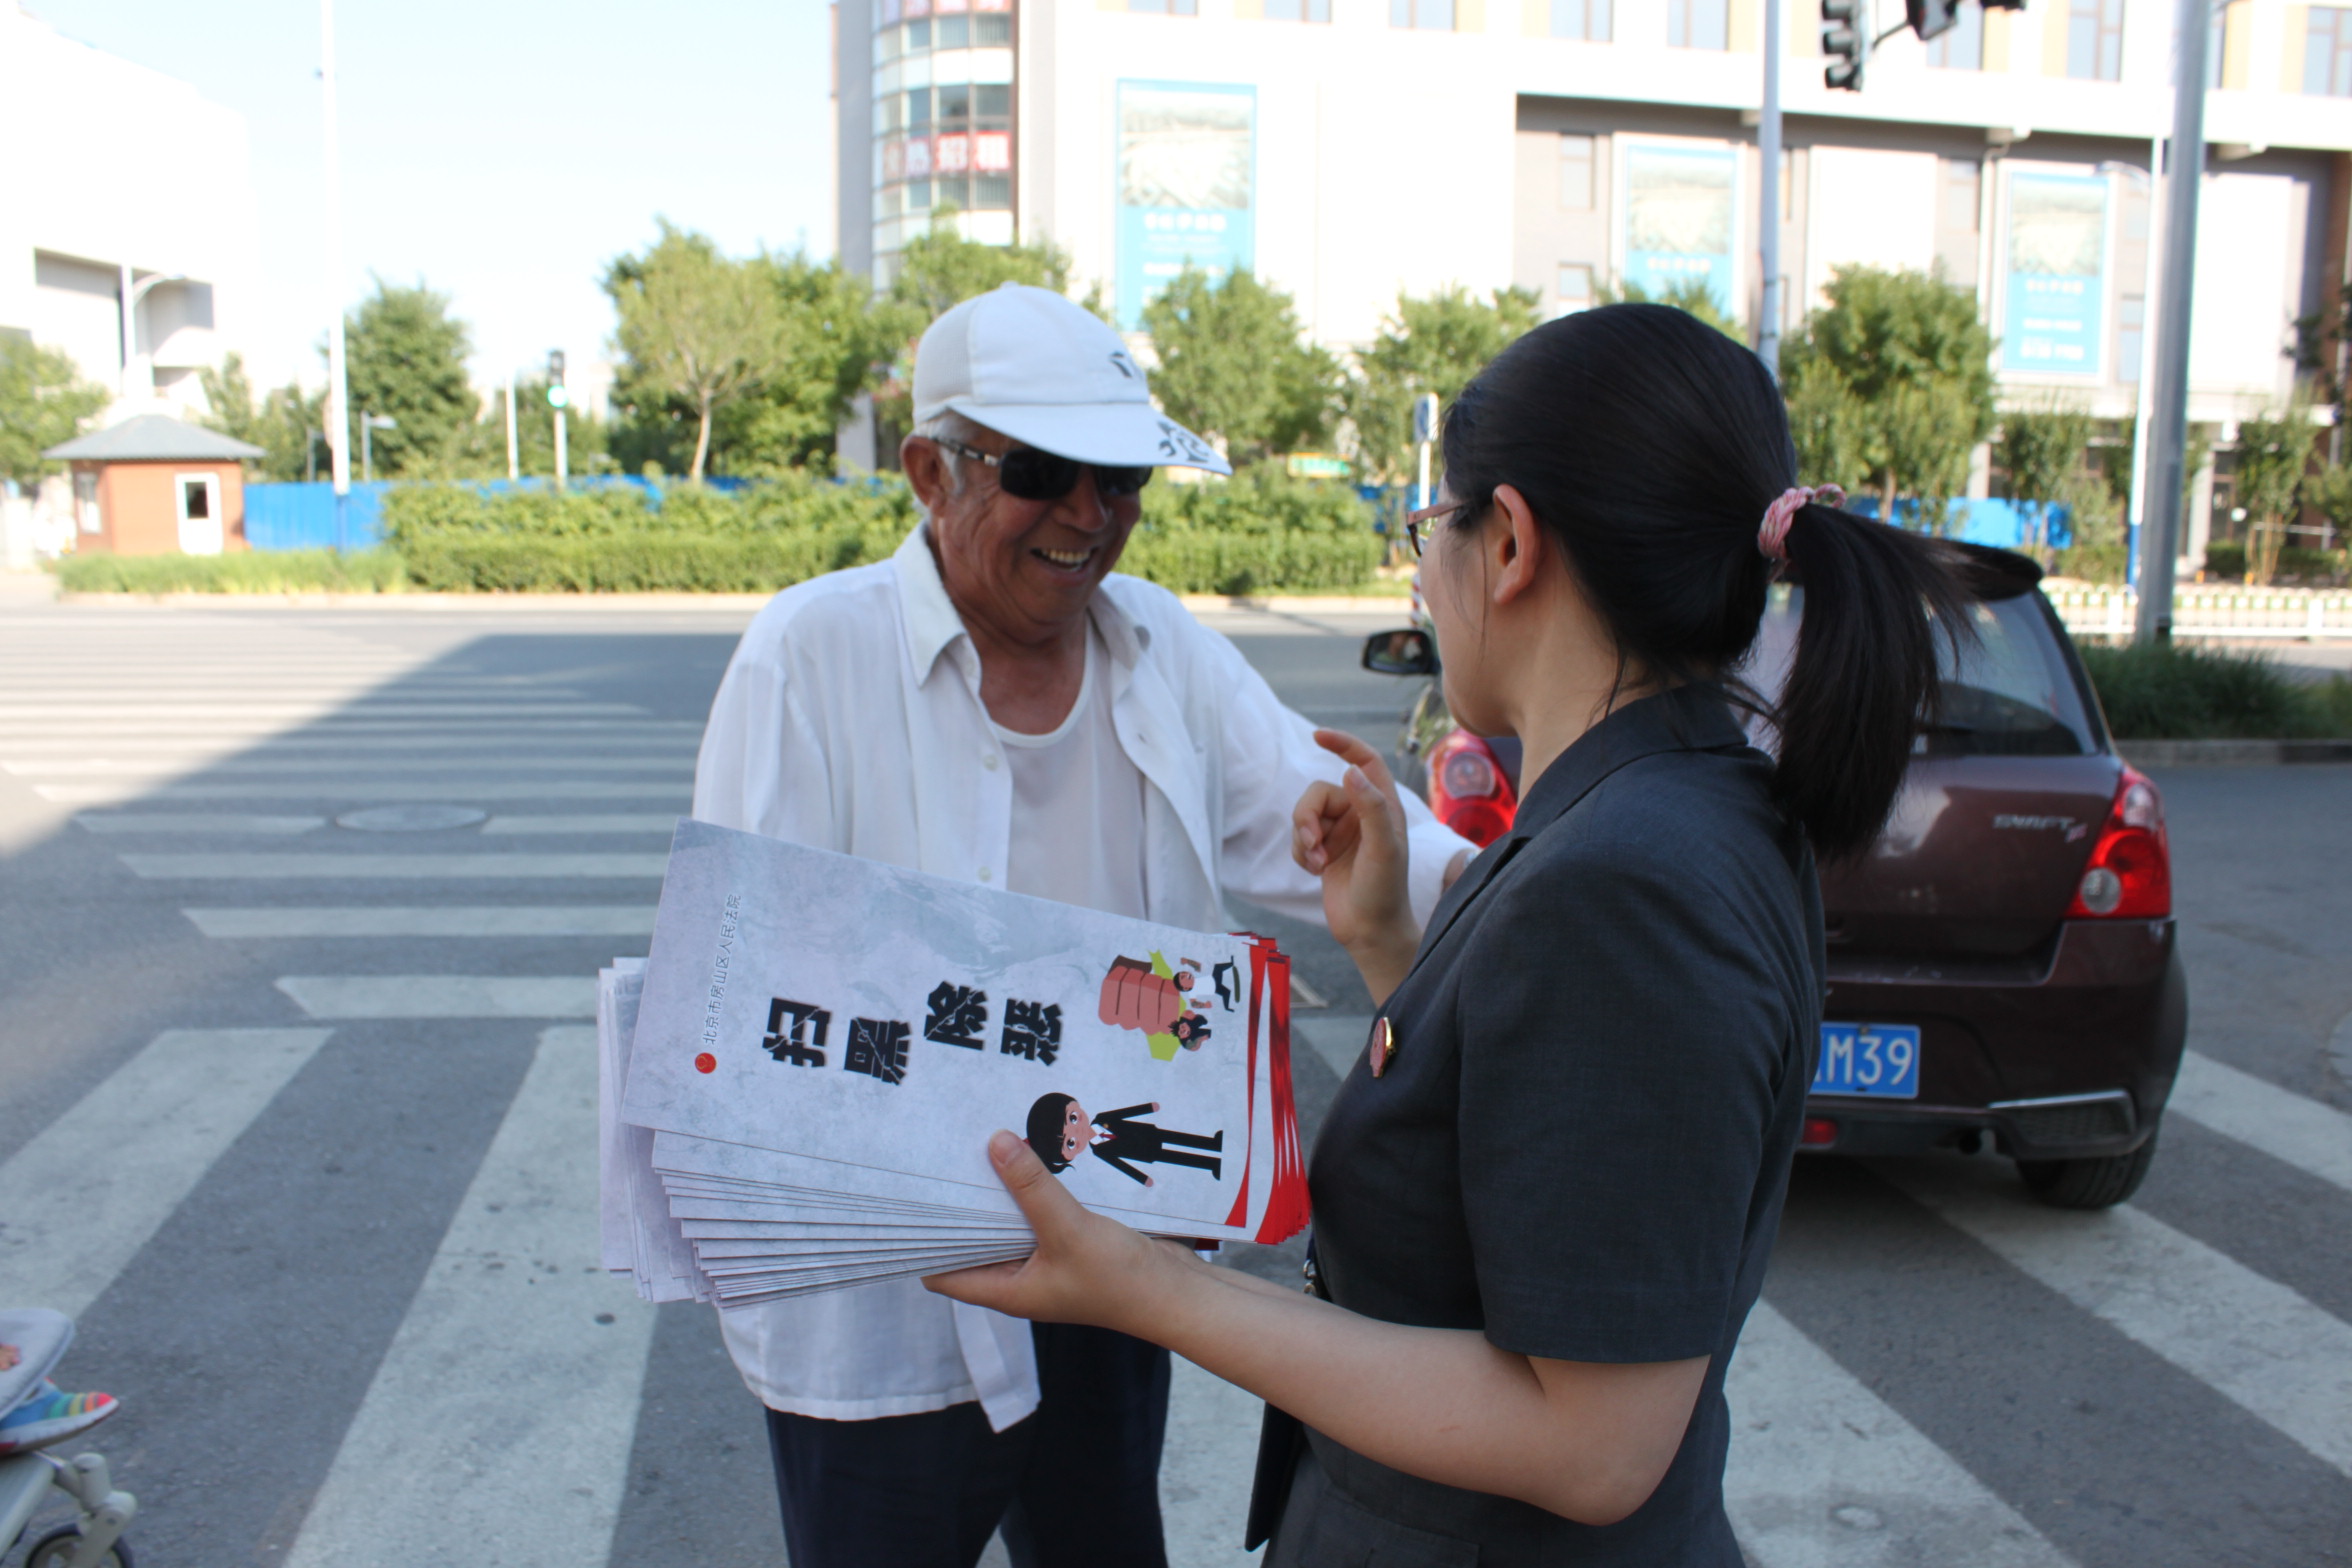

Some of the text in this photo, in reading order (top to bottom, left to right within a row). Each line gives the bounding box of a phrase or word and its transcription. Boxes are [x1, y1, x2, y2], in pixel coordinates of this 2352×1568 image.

[702, 894, 742, 1045] 北京市房山区人民法院
[762, 981, 1062, 1086] 扫黑除恶
[1815, 1034, 1913, 1085] M39
